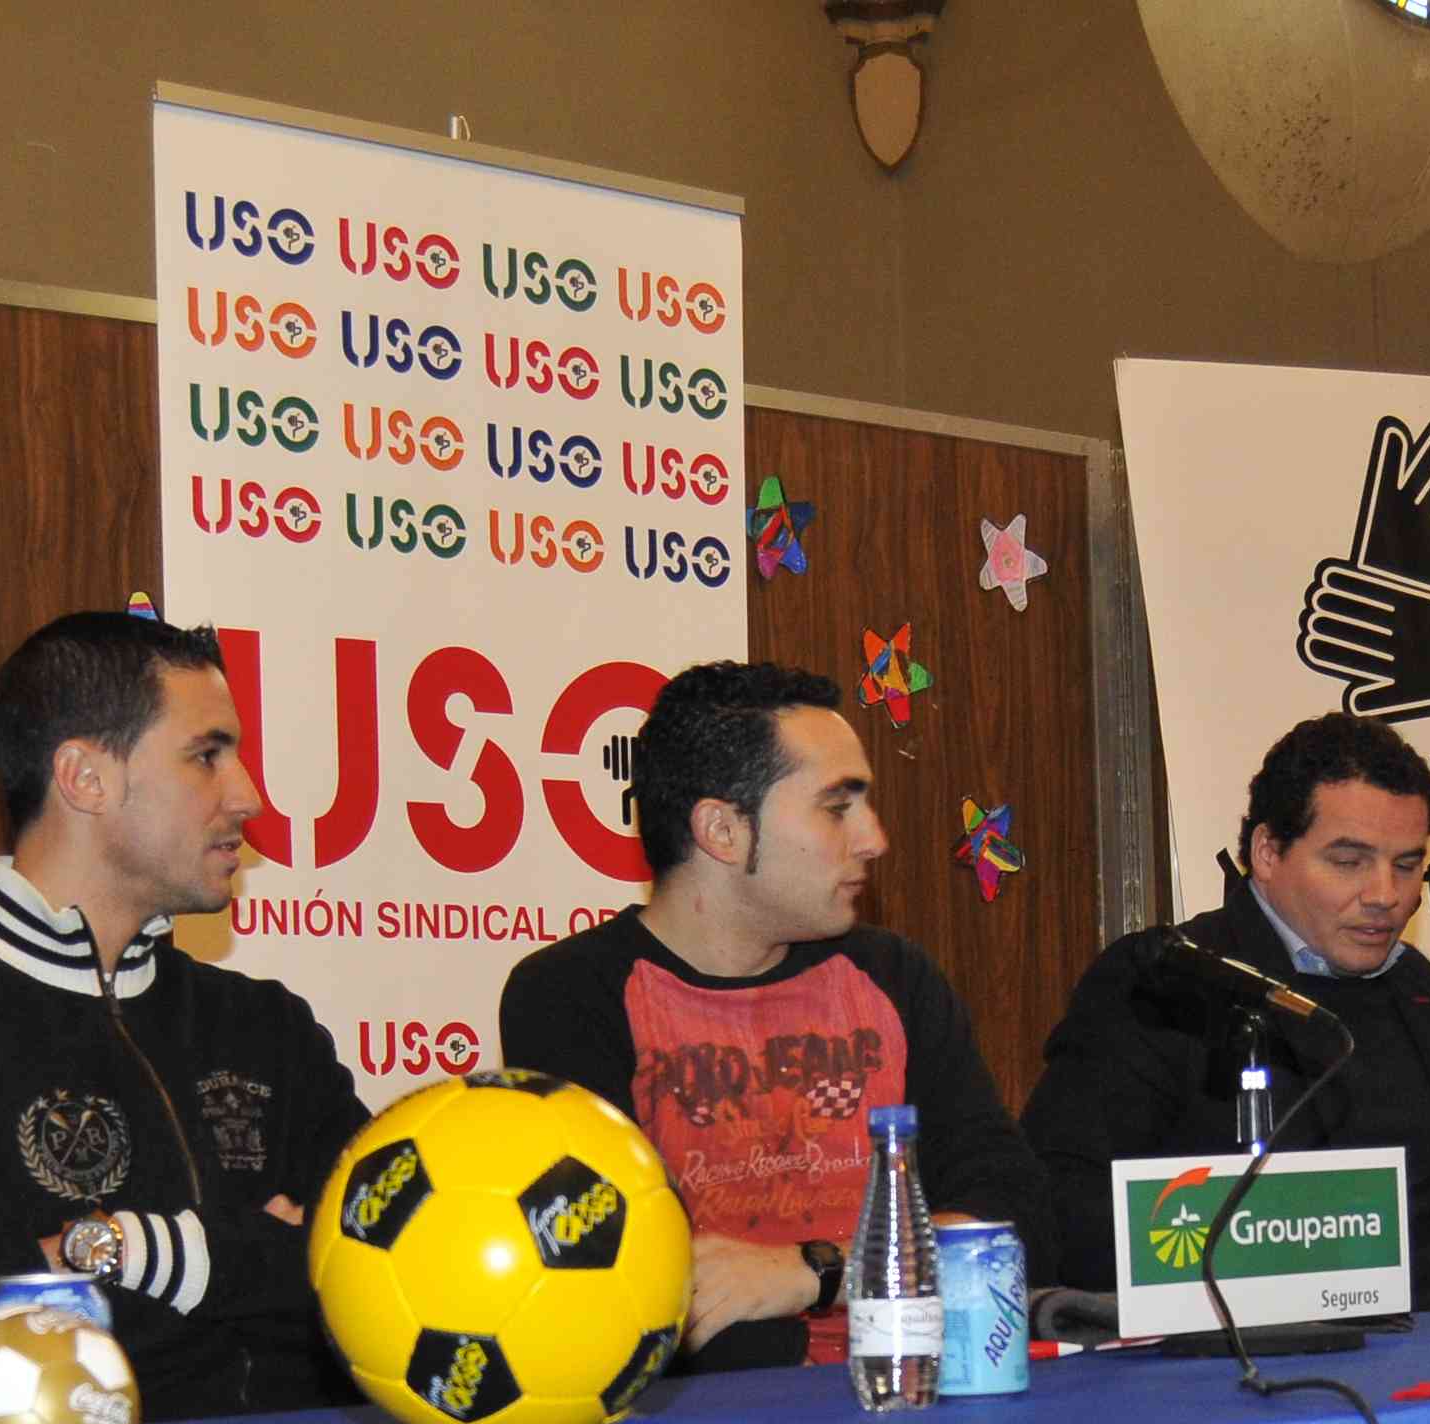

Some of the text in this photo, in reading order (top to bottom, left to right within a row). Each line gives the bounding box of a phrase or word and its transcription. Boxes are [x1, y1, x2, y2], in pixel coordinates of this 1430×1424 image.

[184, 190, 725, 334] USO USO USO USO
[187, 287, 728, 420] USO USO USO USO
[189, 383, 729, 505] USO USO USO USO
[192, 475, 731, 589] USO USO USO USO
[217, 628, 673, 882] USO
[232, 889, 363, 938] UNIÓN
[376, 901, 558, 943] SINDICAL
[359, 1021, 481, 1076] USO
[1229, 1210, 1382, 1249] Groupama
[1321, 1289, 1380, 1312] Seguros
